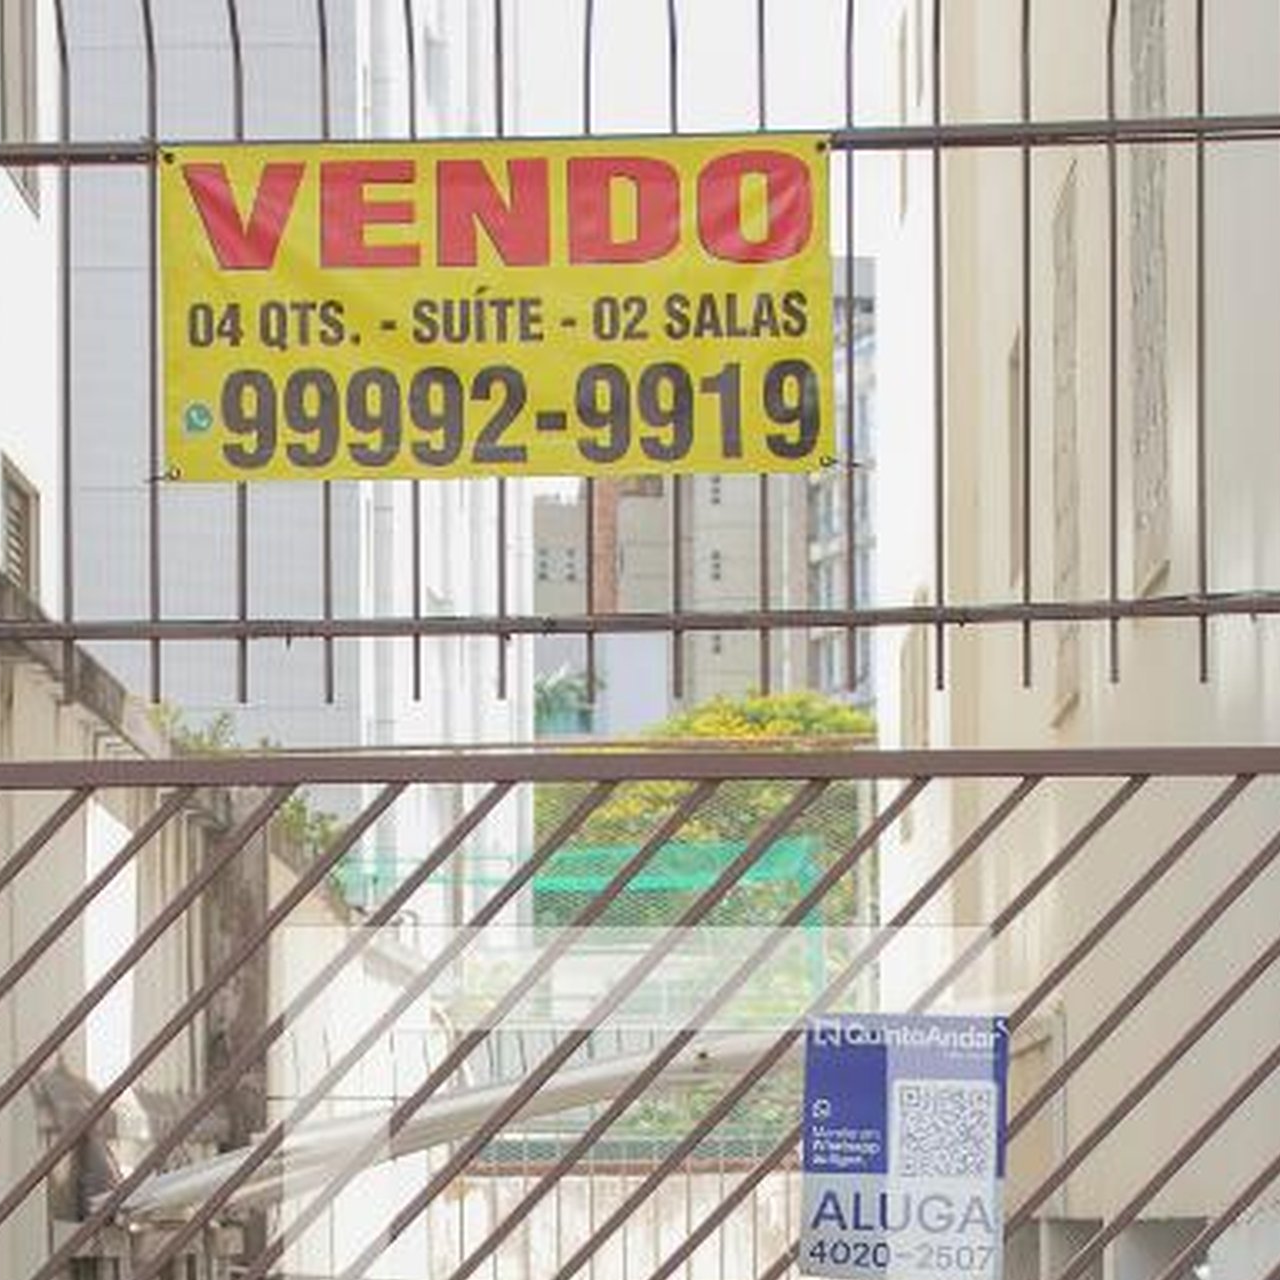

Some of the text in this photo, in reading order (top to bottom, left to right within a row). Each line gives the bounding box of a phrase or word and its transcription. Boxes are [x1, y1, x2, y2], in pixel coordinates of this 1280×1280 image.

[181, 150, 814, 270] VENDO
[188, 301, 243, 347] 04
[259, 300, 362, 348] QTS.
[412, 286, 545, 344] SUÍTE
[593, 294, 649, 341] 02
[664, 290, 808, 340] SALAS
[220, 358, 821, 470] 99992-9919
[845, 1022, 1002, 1050] QuintoAndar
[811, 1190, 995, 1234] ALUGA
[809, 1240, 995, 1271] 4020-2507
